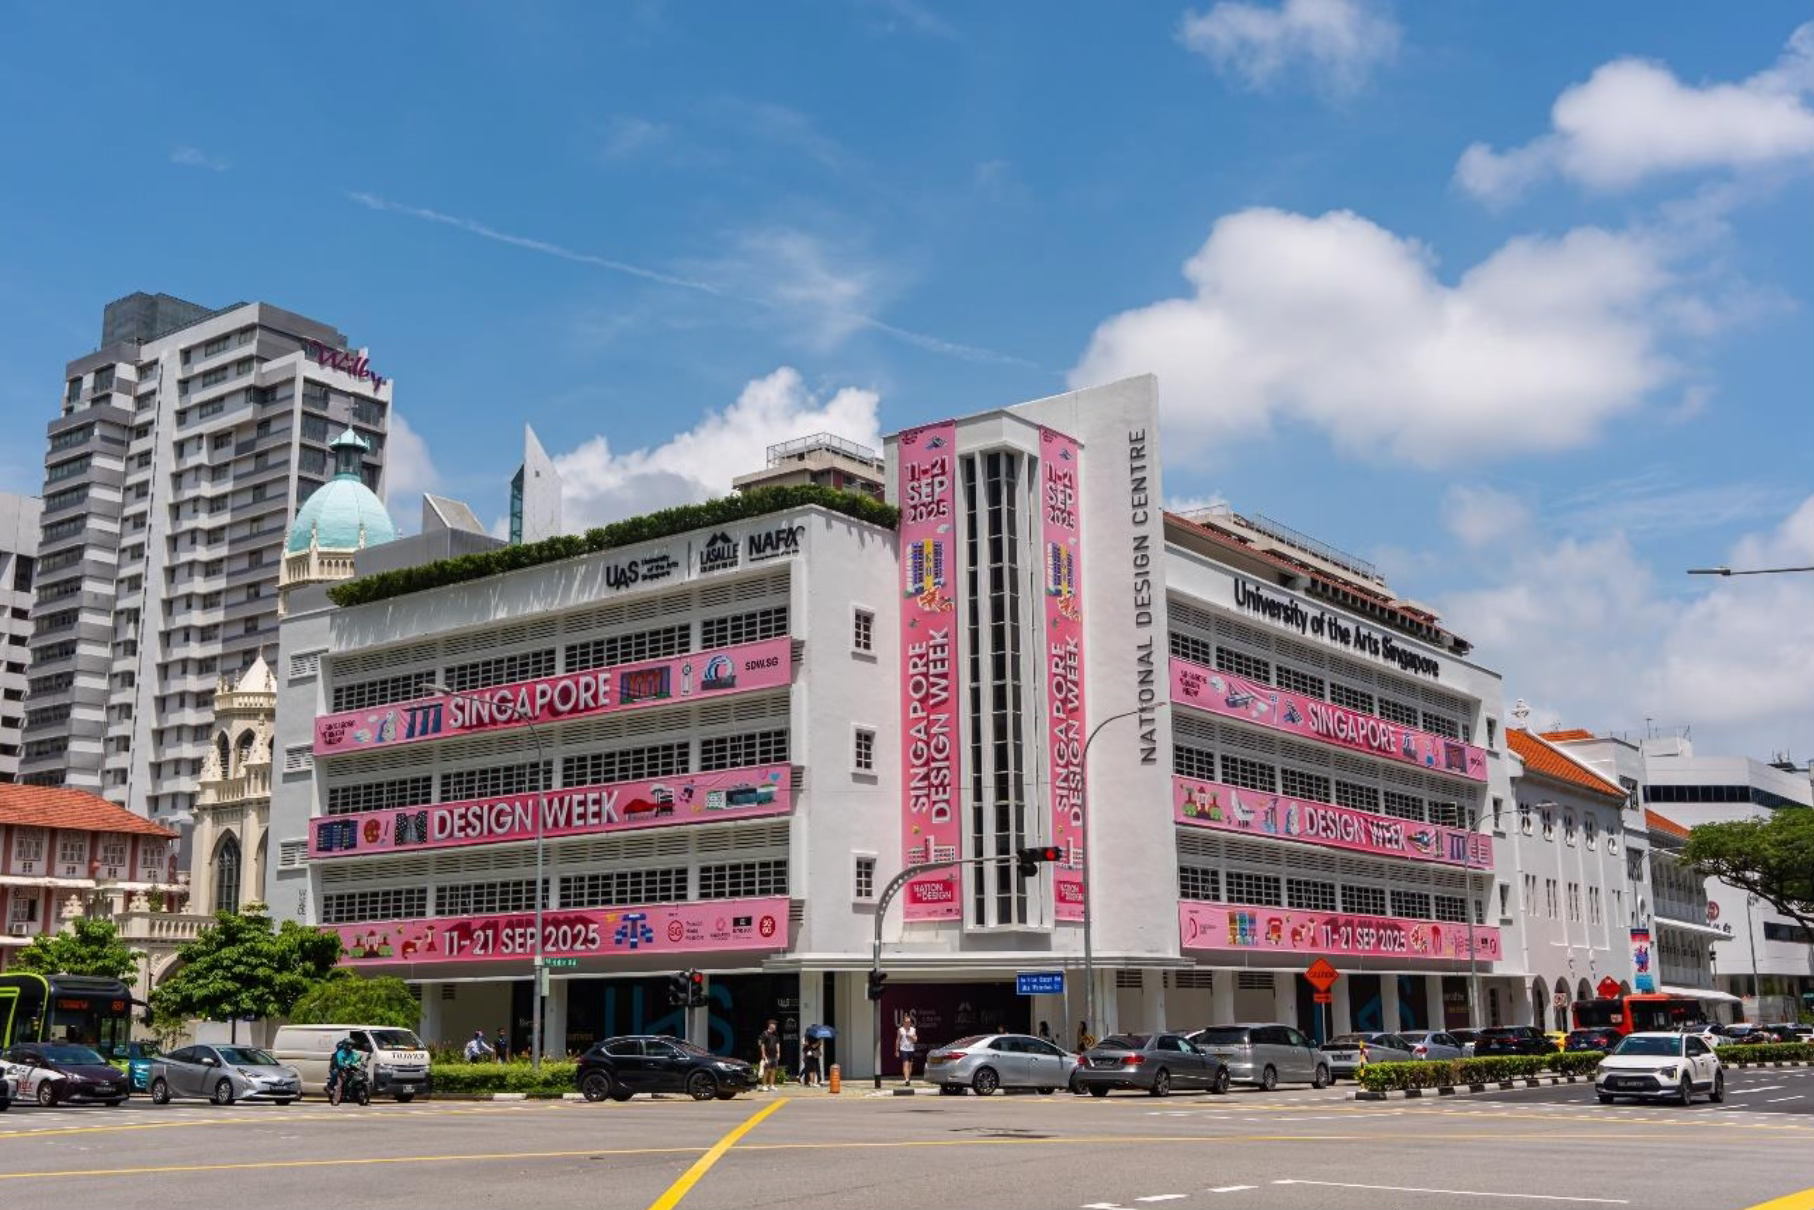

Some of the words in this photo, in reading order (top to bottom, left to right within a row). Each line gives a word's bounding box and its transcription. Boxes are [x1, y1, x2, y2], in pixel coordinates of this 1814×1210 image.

[906, 476, 949, 505] SEP
[1046, 483, 1074, 508] SEP
[1129, 428, 1147, 526] CENTRE
[906, 502, 949, 525] 2025
[1047, 506, 1075, 531] 2025
[605, 560, 640, 590] UAS
[700, 543, 738, 565] LASALLE
[1134, 536, 1154, 629] DESIGN
[1234, 577, 1307, 635] University
[1311, 606, 1326, 637] of
[1328, 612, 1351, 645] the
[1353, 624, 1380, 655] Arts
[1381, 635, 1439, 678] Singapore
[744, 656, 779, 671] SDW.SG
[929, 626, 950, 708] WEEK
[1066, 635, 1080, 711] WEEK
[448, 673, 612, 730] SINGAPORE
[1135, 635, 1158, 767] NATIONAL
[909, 640, 929, 815] SINGAPORE
[1051, 641, 1070, 816] SINGAPORE
[1307, 702, 1397, 752] SINGAPORE
[931, 714, 952, 825] DESIGN
[1067, 719, 1083, 828] DESIGN
[433, 799, 534, 840] DESIGN
[540, 789, 620, 830] WEEK
[1305, 807, 1365, 844] DESIGN
[1368, 821, 1407, 852] WEEK
[444, 927, 494, 957] 11-21
[501, 925, 538, 955] SEP
[544, 922, 601, 952] 2025
[1320, 926, 1352, 949] 11-21
[1355, 930, 1377, 950] SEP
[1378, 934, 1408, 954] 2025
